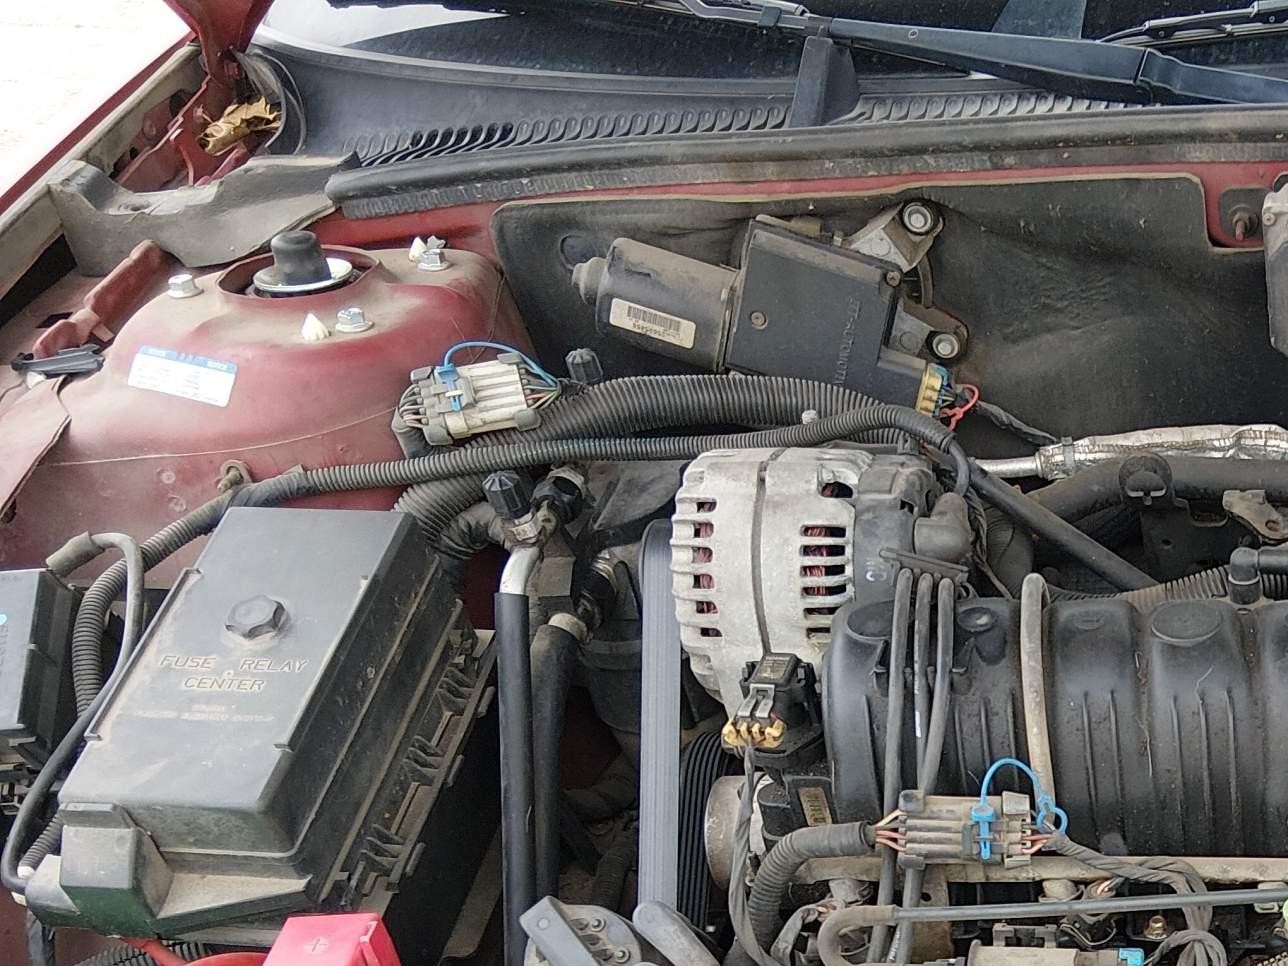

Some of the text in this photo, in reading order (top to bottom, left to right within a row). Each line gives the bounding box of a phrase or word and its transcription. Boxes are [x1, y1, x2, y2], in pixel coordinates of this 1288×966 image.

[160, 655, 308, 672] FUSE RELAY
[183, 677, 265, 691] CENTER
